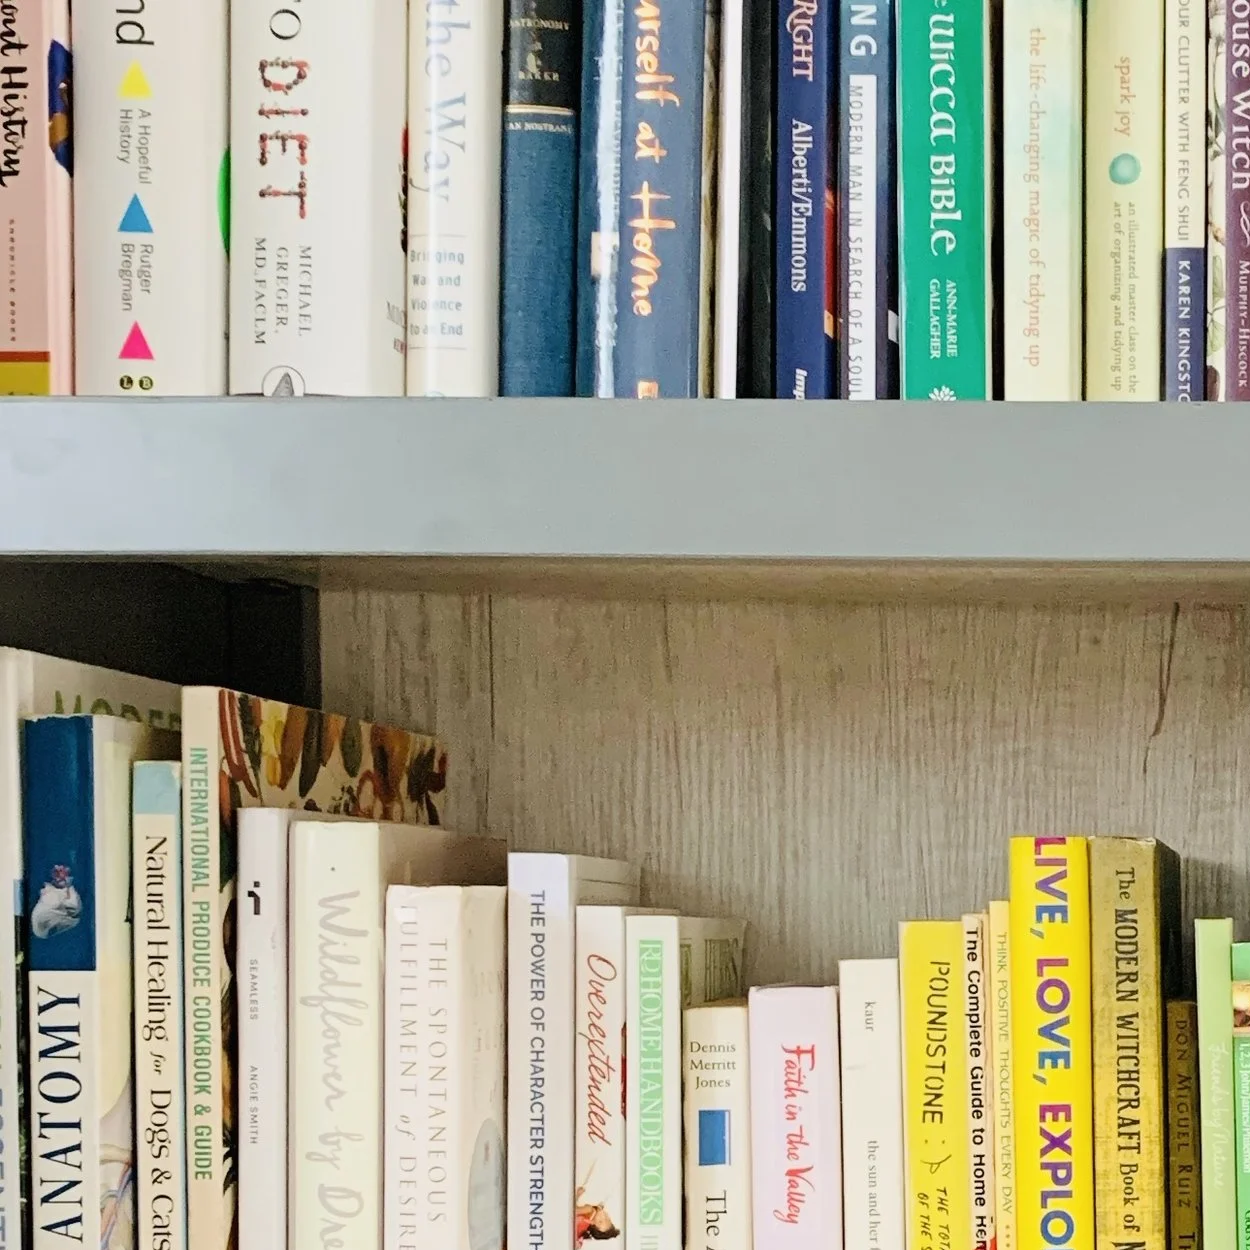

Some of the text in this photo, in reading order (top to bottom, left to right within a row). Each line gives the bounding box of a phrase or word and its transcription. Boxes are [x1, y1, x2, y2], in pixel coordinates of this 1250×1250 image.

[1115, 56, 1137, 137] spark joy
[117, 109, 134, 164] History
[138, 110, 153, 185] A Hopeful
[257, 59, 311, 219] DIET
[1177, 36, 1191, 241] CLUTTER WITH FENG SHUI
[791, 119, 813, 292] Alberti/Emmons
[1023, 28, 1047, 368] the life-changing magic of tidying up
[120, 243, 136, 312] Bregman
[139, 244, 153, 295] Rutger
[849, 86, 864, 398] MODERN MAN IN SEARCH OF A SOUL
[298, 246, 313, 337] MICHAEL
[929, 279, 942, 360] GALLAGHER
[945, 279, 958, 358] ANN-MARIE
[1177, 260, 1191, 319] KAREN
[144, 835, 171, 937] Natural
[529, 890, 546, 927] THE
[1029, 836, 1069, 940] LIVE,
[1114, 866, 1136, 901] The
[142, 941, 174, 1041] Healing
[189, 747, 213, 1181] INTERNATIONAL PRODUCE COOKBOOK & GUIDE
[529, 932, 546, 1001] POWER
[1113, 907, 1139, 1004] MODERN
[529, 1002, 546, 1033] OF
[577, 953, 618, 1147] Overextended
[689, 1040, 736, 1055] Dennis
[1032, 957, 1072, 1086] LOVE,
[150, 1051, 166, 1076] for
[529, 1037, 546, 1149] CHARACTER
[689, 1057, 737, 1072] Merritt
[694, 1075, 732, 1090] Jones
[1116, 1011, 1141, 1155] WITCHCRAFT
[144, 1088, 172, 1165] Dogs
[150, 1167, 172, 1187] &
[705, 1190, 727, 1237] The
[1119, 1163, 1139, 1206] Book
[1124, 1215, 1140, 1233] of
